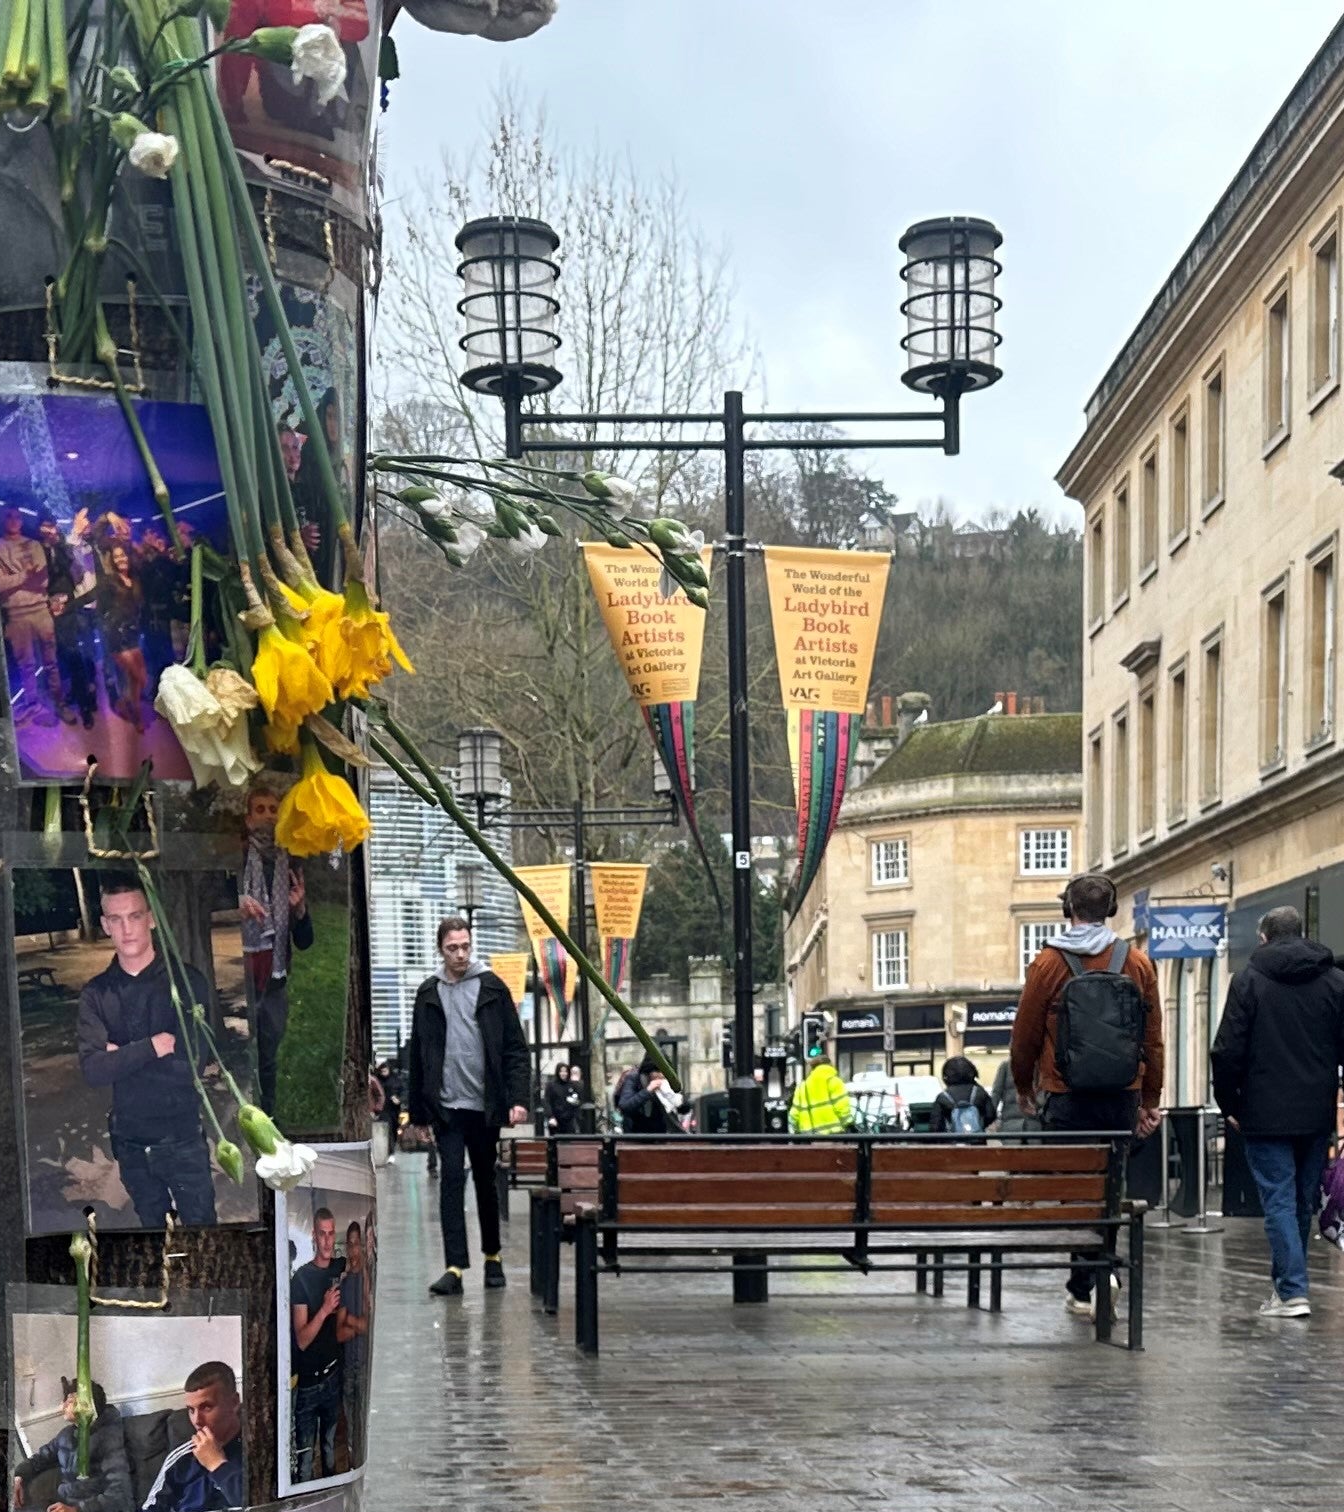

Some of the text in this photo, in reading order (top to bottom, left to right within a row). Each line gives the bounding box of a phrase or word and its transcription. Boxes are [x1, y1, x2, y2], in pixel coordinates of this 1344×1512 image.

[784, 568, 870, 583] The Wonderful
[792, 583, 863, 597] World of the
[784, 597, 870, 618] Ladybird
[627, 610, 676, 625] Book
[802, 617, 851, 634] Book
[621, 628, 686, 647] Artists
[793, 636, 858, 654] Artists
[637, 646, 684, 659] Victoria
[643, 660, 687, 674] Gallery
[795, 656, 856, 669] at Victoria
[792, 669, 858, 685] Art Gallery
[739, 855, 748, 866] 5
[1151, 924, 1221, 940] HALIFAX
